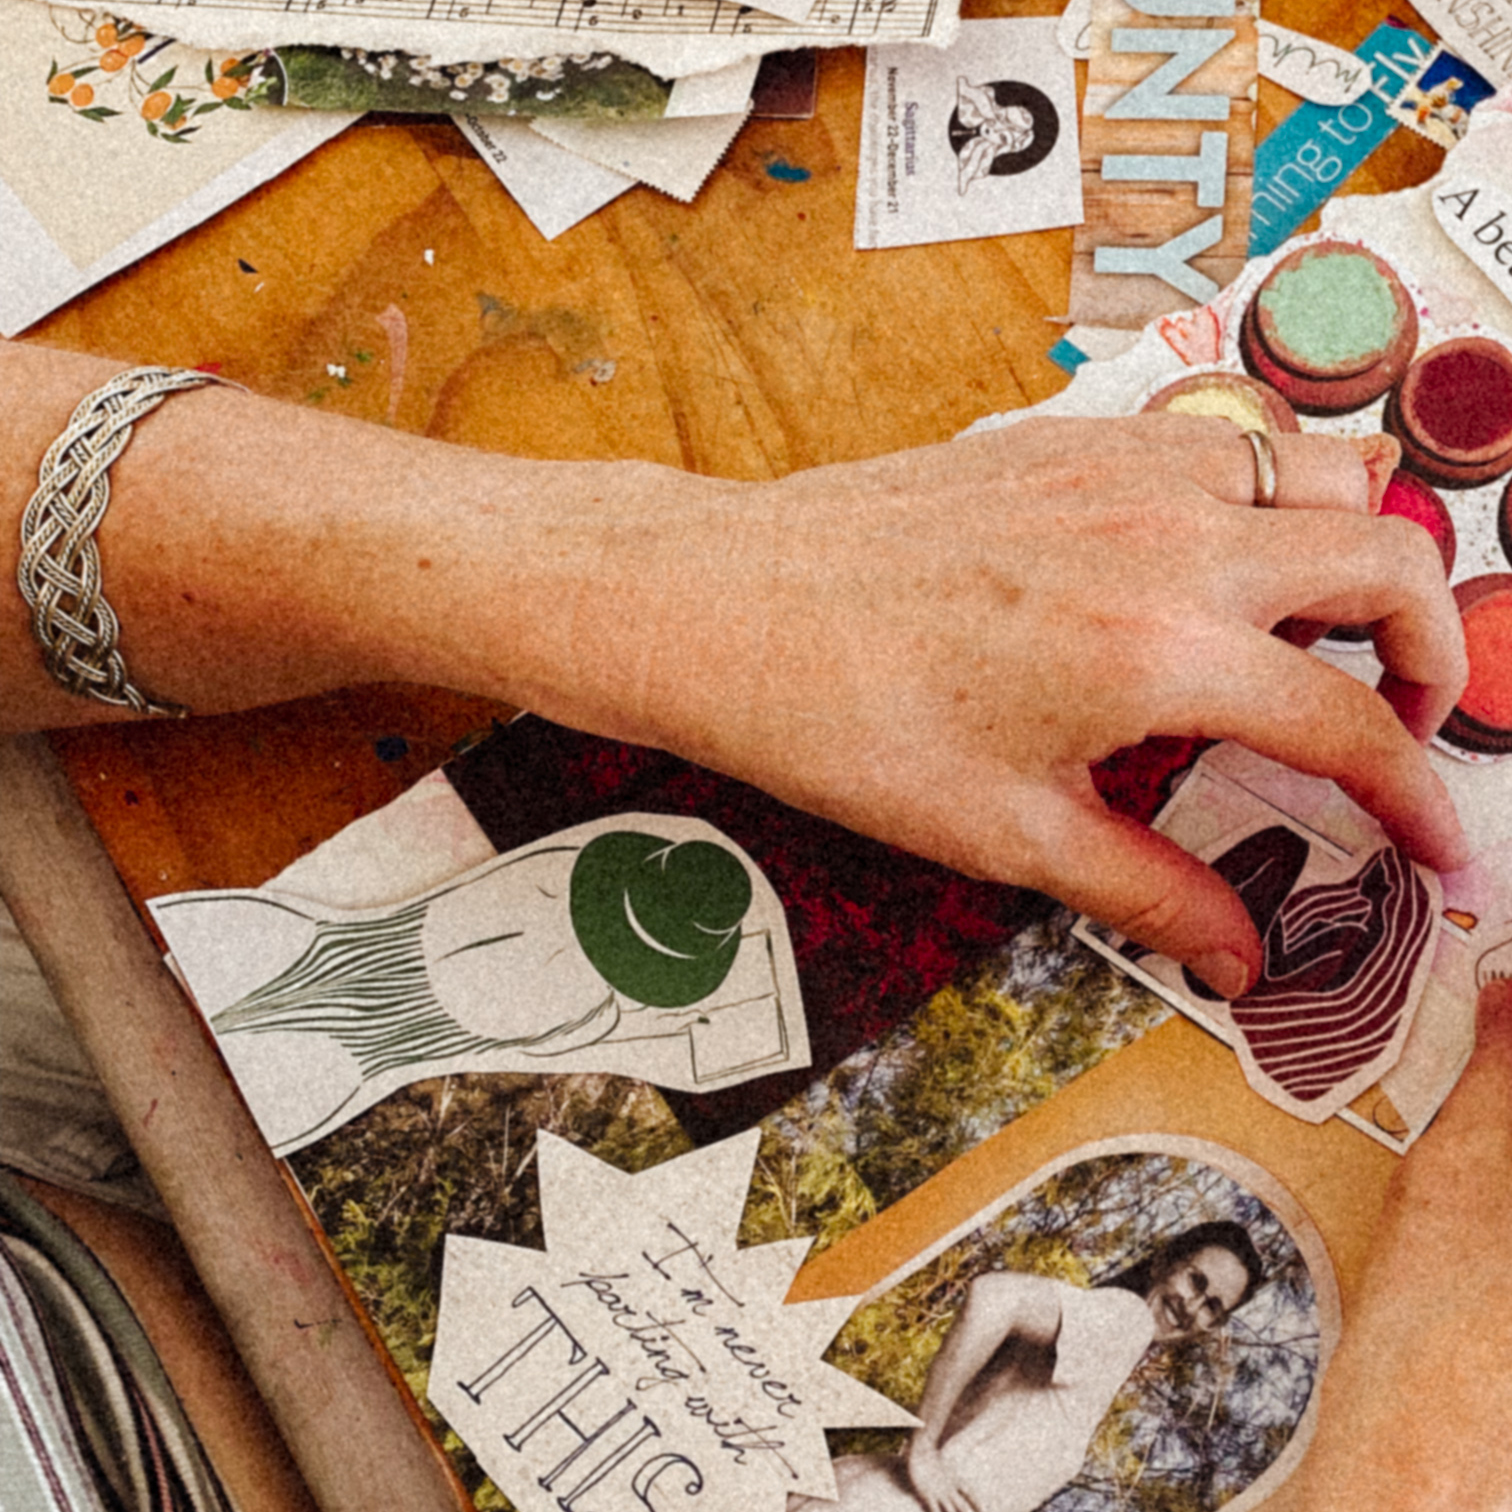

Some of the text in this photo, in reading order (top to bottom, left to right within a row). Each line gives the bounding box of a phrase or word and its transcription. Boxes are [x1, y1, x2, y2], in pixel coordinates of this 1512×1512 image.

[886, 66, 899, 214] November 22-December 21
[902, 101, 919, 177] Sagittarius
[1093, 0, 1236, 306] NTY
[1249, 138, 1344, 241] ning
[1316, 101, 1373, 146] to
[1438, 187, 1480, 221] A
[560, 1272, 799, 1481] parting with
[641, 1221, 803, 1420] I'm never
